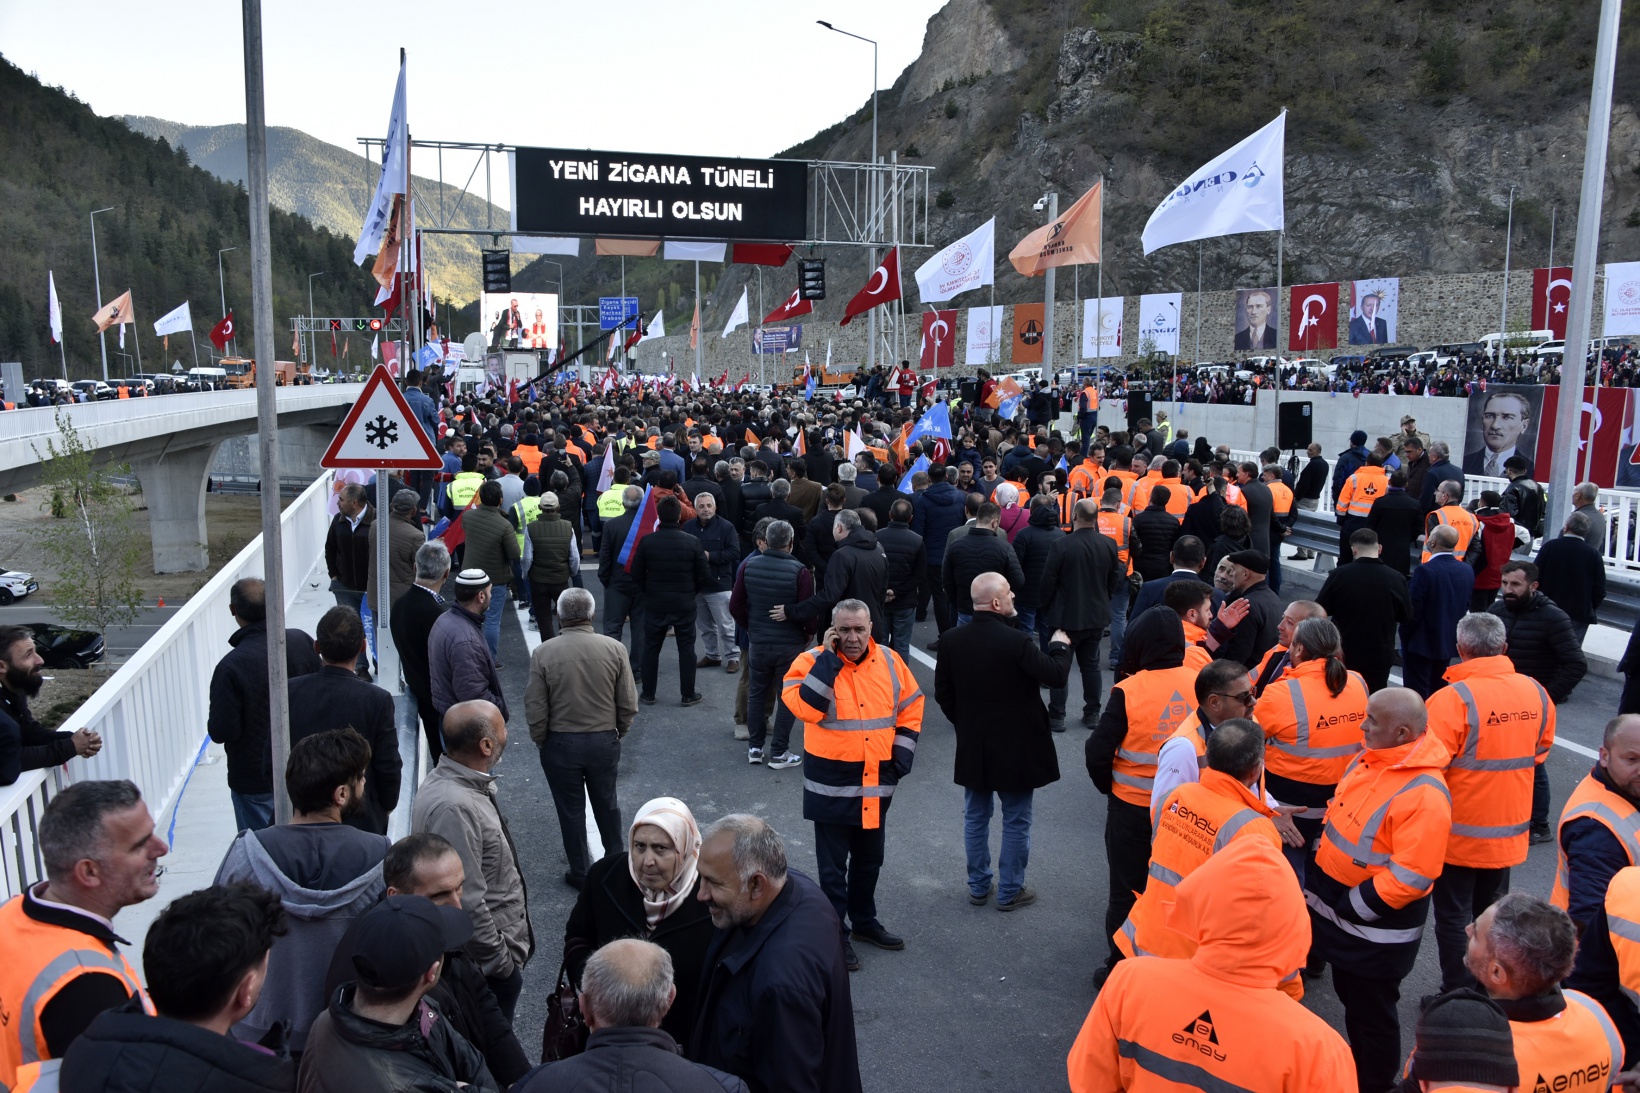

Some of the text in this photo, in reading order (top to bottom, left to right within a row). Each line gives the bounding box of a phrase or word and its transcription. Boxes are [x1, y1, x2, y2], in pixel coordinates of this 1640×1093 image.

[579, 197, 743, 222] HAYIRLI OLSUN
[363, 614, 373, 629] AK
[1328, 710, 1365, 726] emay
[1500, 710, 1538, 723] emay
[1178, 806, 1218, 836] emay
[1171, 1032, 1227, 1062] emay
[1553, 1056, 1609, 1092] emay
